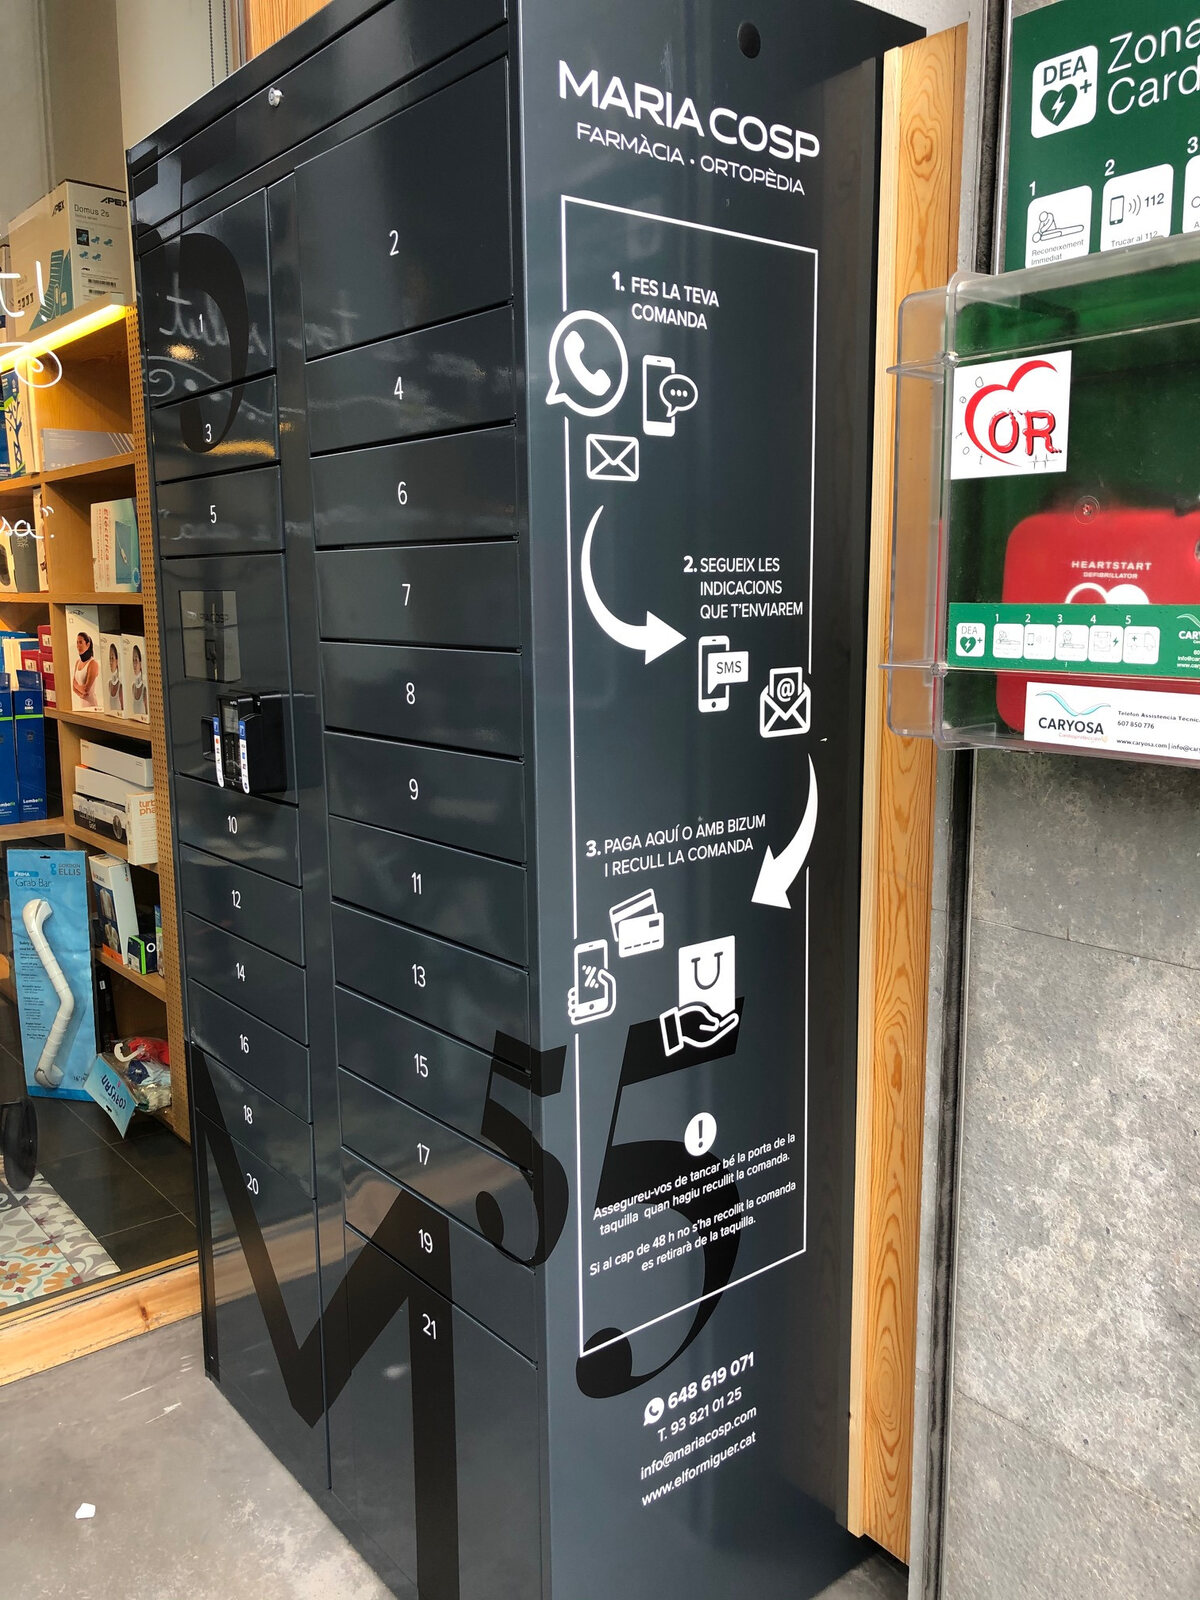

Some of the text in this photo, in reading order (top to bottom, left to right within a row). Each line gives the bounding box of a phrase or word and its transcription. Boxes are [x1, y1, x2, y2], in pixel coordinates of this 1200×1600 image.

[1107, 18, 1200, 74] Zona
[1043, 55, 1088, 86] DEA
[1107, 54, 1200, 115] Card
[559, 59, 821, 163] MARIA COSP
[1187, 136, 1198, 153] 3
[576, 122, 685, 166] FARMÀCIA
[700, 155, 805, 195] ORTOPÈDIA
[1104, 159, 1115, 177] 2
[1029, 181, 1036, 196] 1
[74, 204, 99, 215] Domus
[1145, 192, 1165, 209] 112
[389, 230, 399, 256] 2
[1031, 239, 1084, 257] Reconeixement
[1111, 237, 1134, 248] Trucar
[1031, 254, 1062, 265] Immediat
[612, 271, 719, 307] 1. FES LA TEVA
[198, 314, 204, 332] 1
[632, 303, 708, 330] COMANDA
[394, 376, 403, 400] 4
[205, 424, 212, 443] 3
[397, 481, 408, 505] 6
[210, 504, 216, 524] 5
[684, 555, 780, 573] 2. SEGUEIX LES
[1071, 560, 1152, 571] HEARTSTART
[1083, 571, 1138, 579] DEFIBRILLATOR
[402, 584, 411, 606] 7
[700, 580, 782, 596] INDICACIONS
[700, 601, 803, 619] QUE T'ENVIAREM
[995, 614, 999, 622] 1
[1025, 614, 1030, 622] 2
[1057, 614, 1063, 623] 3
[1090, 615, 1096, 623] 4
[1125, 615, 1131, 624] 5
[961, 625, 978, 635] DEA
[716, 661, 742, 674] SMS
[406, 682, 415, 705] 8
[1038, 717, 1104, 735] CARYOSA
[1141, 713, 1177, 721] Assistencia
[1116, 738, 1167, 749] www.caryosa.com
[409, 778, 419, 800] 9
[227, 816, 238, 835] 10
[586, 814, 766, 857] 3. PAGA AQUÍ O AMB BIZUM
[604, 838, 753, 878] I RECULL LA COMANDA
[15, 878, 51, 888] Grab Bar
[411, 872, 422, 895] 11
[231, 890, 242, 910] 12
[235, 963, 245, 982] 14
[412, 964, 426, 987] 13
[239, 1035, 249, 1054] 16
[414, 1053, 428, 1077] 15
[243, 1105, 253, 1125] 18
[417, 1142, 430, 1166] 17
[247, 1174, 259, 1195] 20
[593, 1133, 795, 1220] Assegureu-vos de tancar bé la porta de la
[600, 1151, 790, 1236] taquilla quan hagiu recullit la comanda.
[590, 1180, 796, 1276] Si al cap de 48 h no s'ha recollit la comanda
[418, 1229, 433, 1254] 19
[642, 1214, 756, 1272] es retirarà de la taquilla.
[422, 1313, 436, 1340] 21
[668, 1352, 754, 1409] 648 619 071
[657, 1387, 742, 1442] T. 93 821 01 25
[640, 1406, 757, 1480] info@mariacosp.com
[641, 1431, 757, 1506] www.elformiguer.cat
